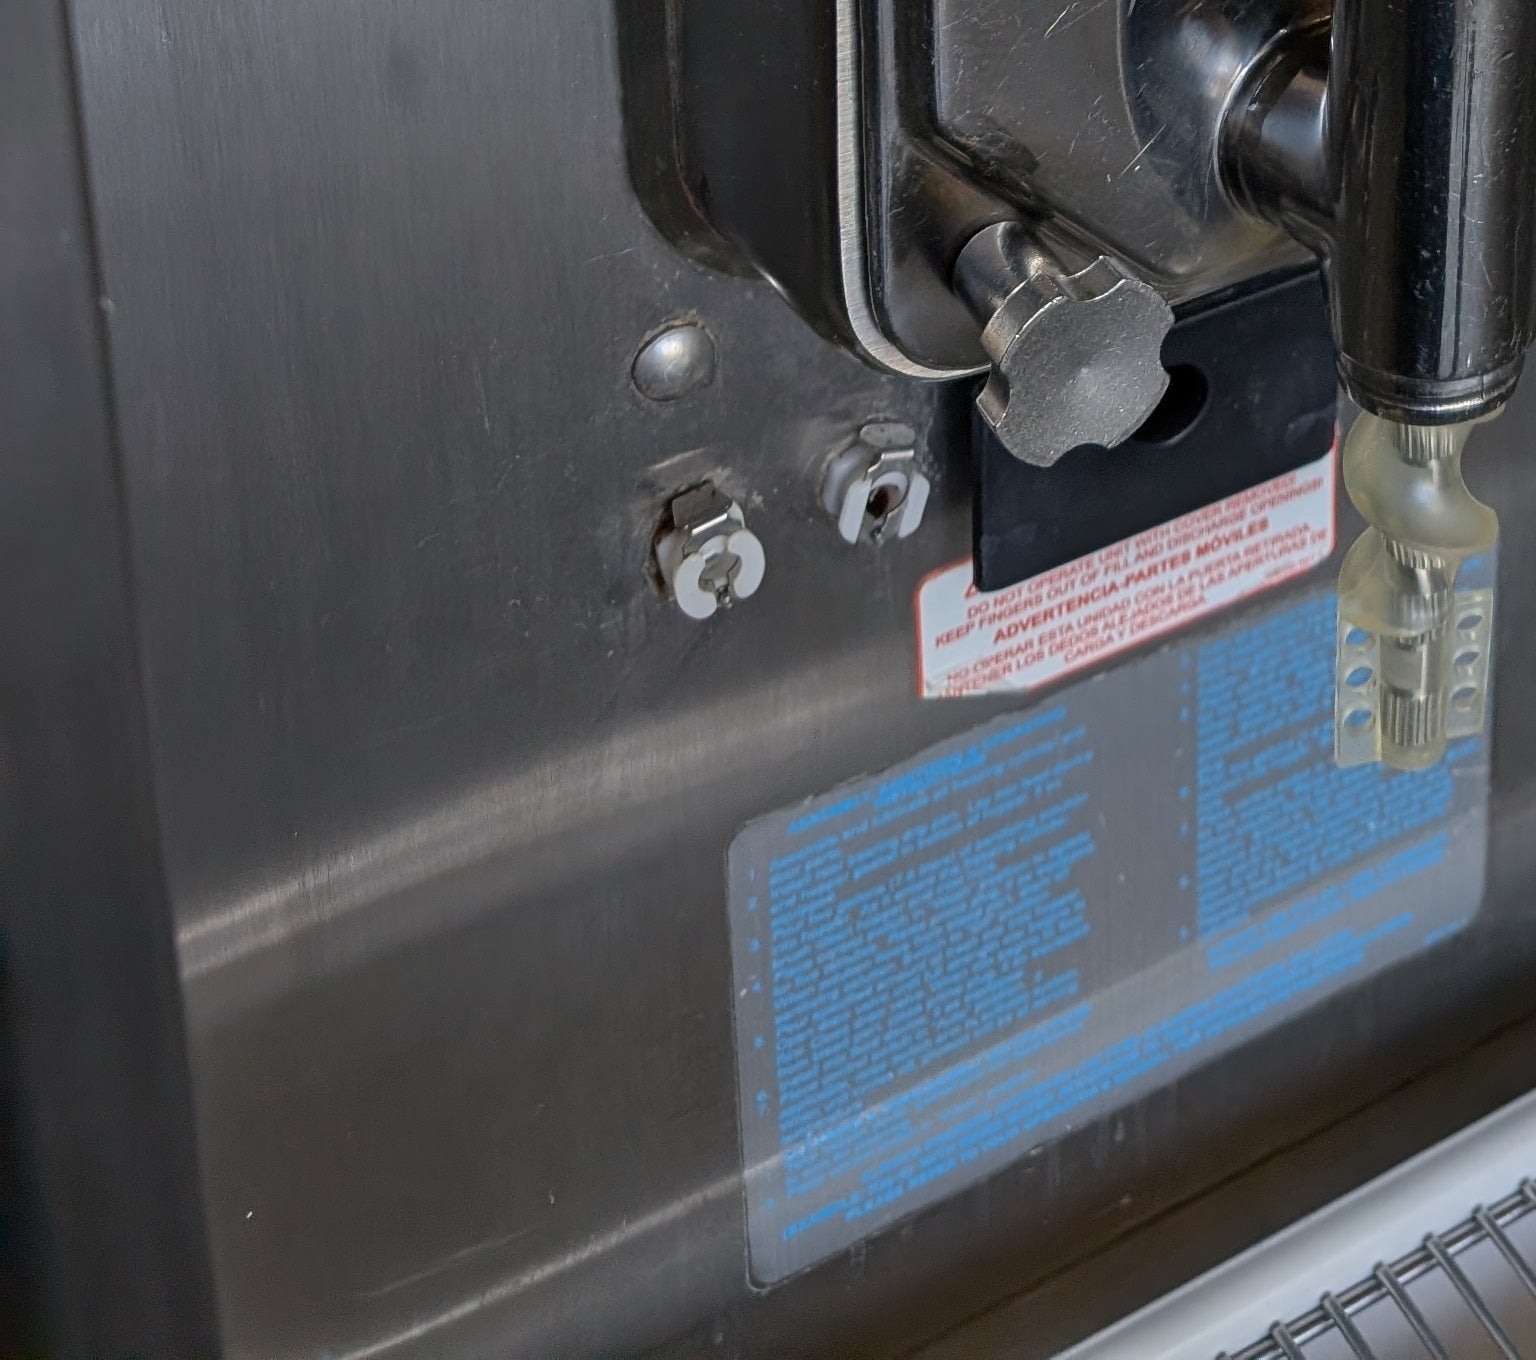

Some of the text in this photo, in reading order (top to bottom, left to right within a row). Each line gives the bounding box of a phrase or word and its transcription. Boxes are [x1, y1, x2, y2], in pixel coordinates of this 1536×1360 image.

[935, 620, 974, 647] KEEP
[979, 592, 1041, 629] FINGERS
[1046, 577, 1076, 601] OUT
